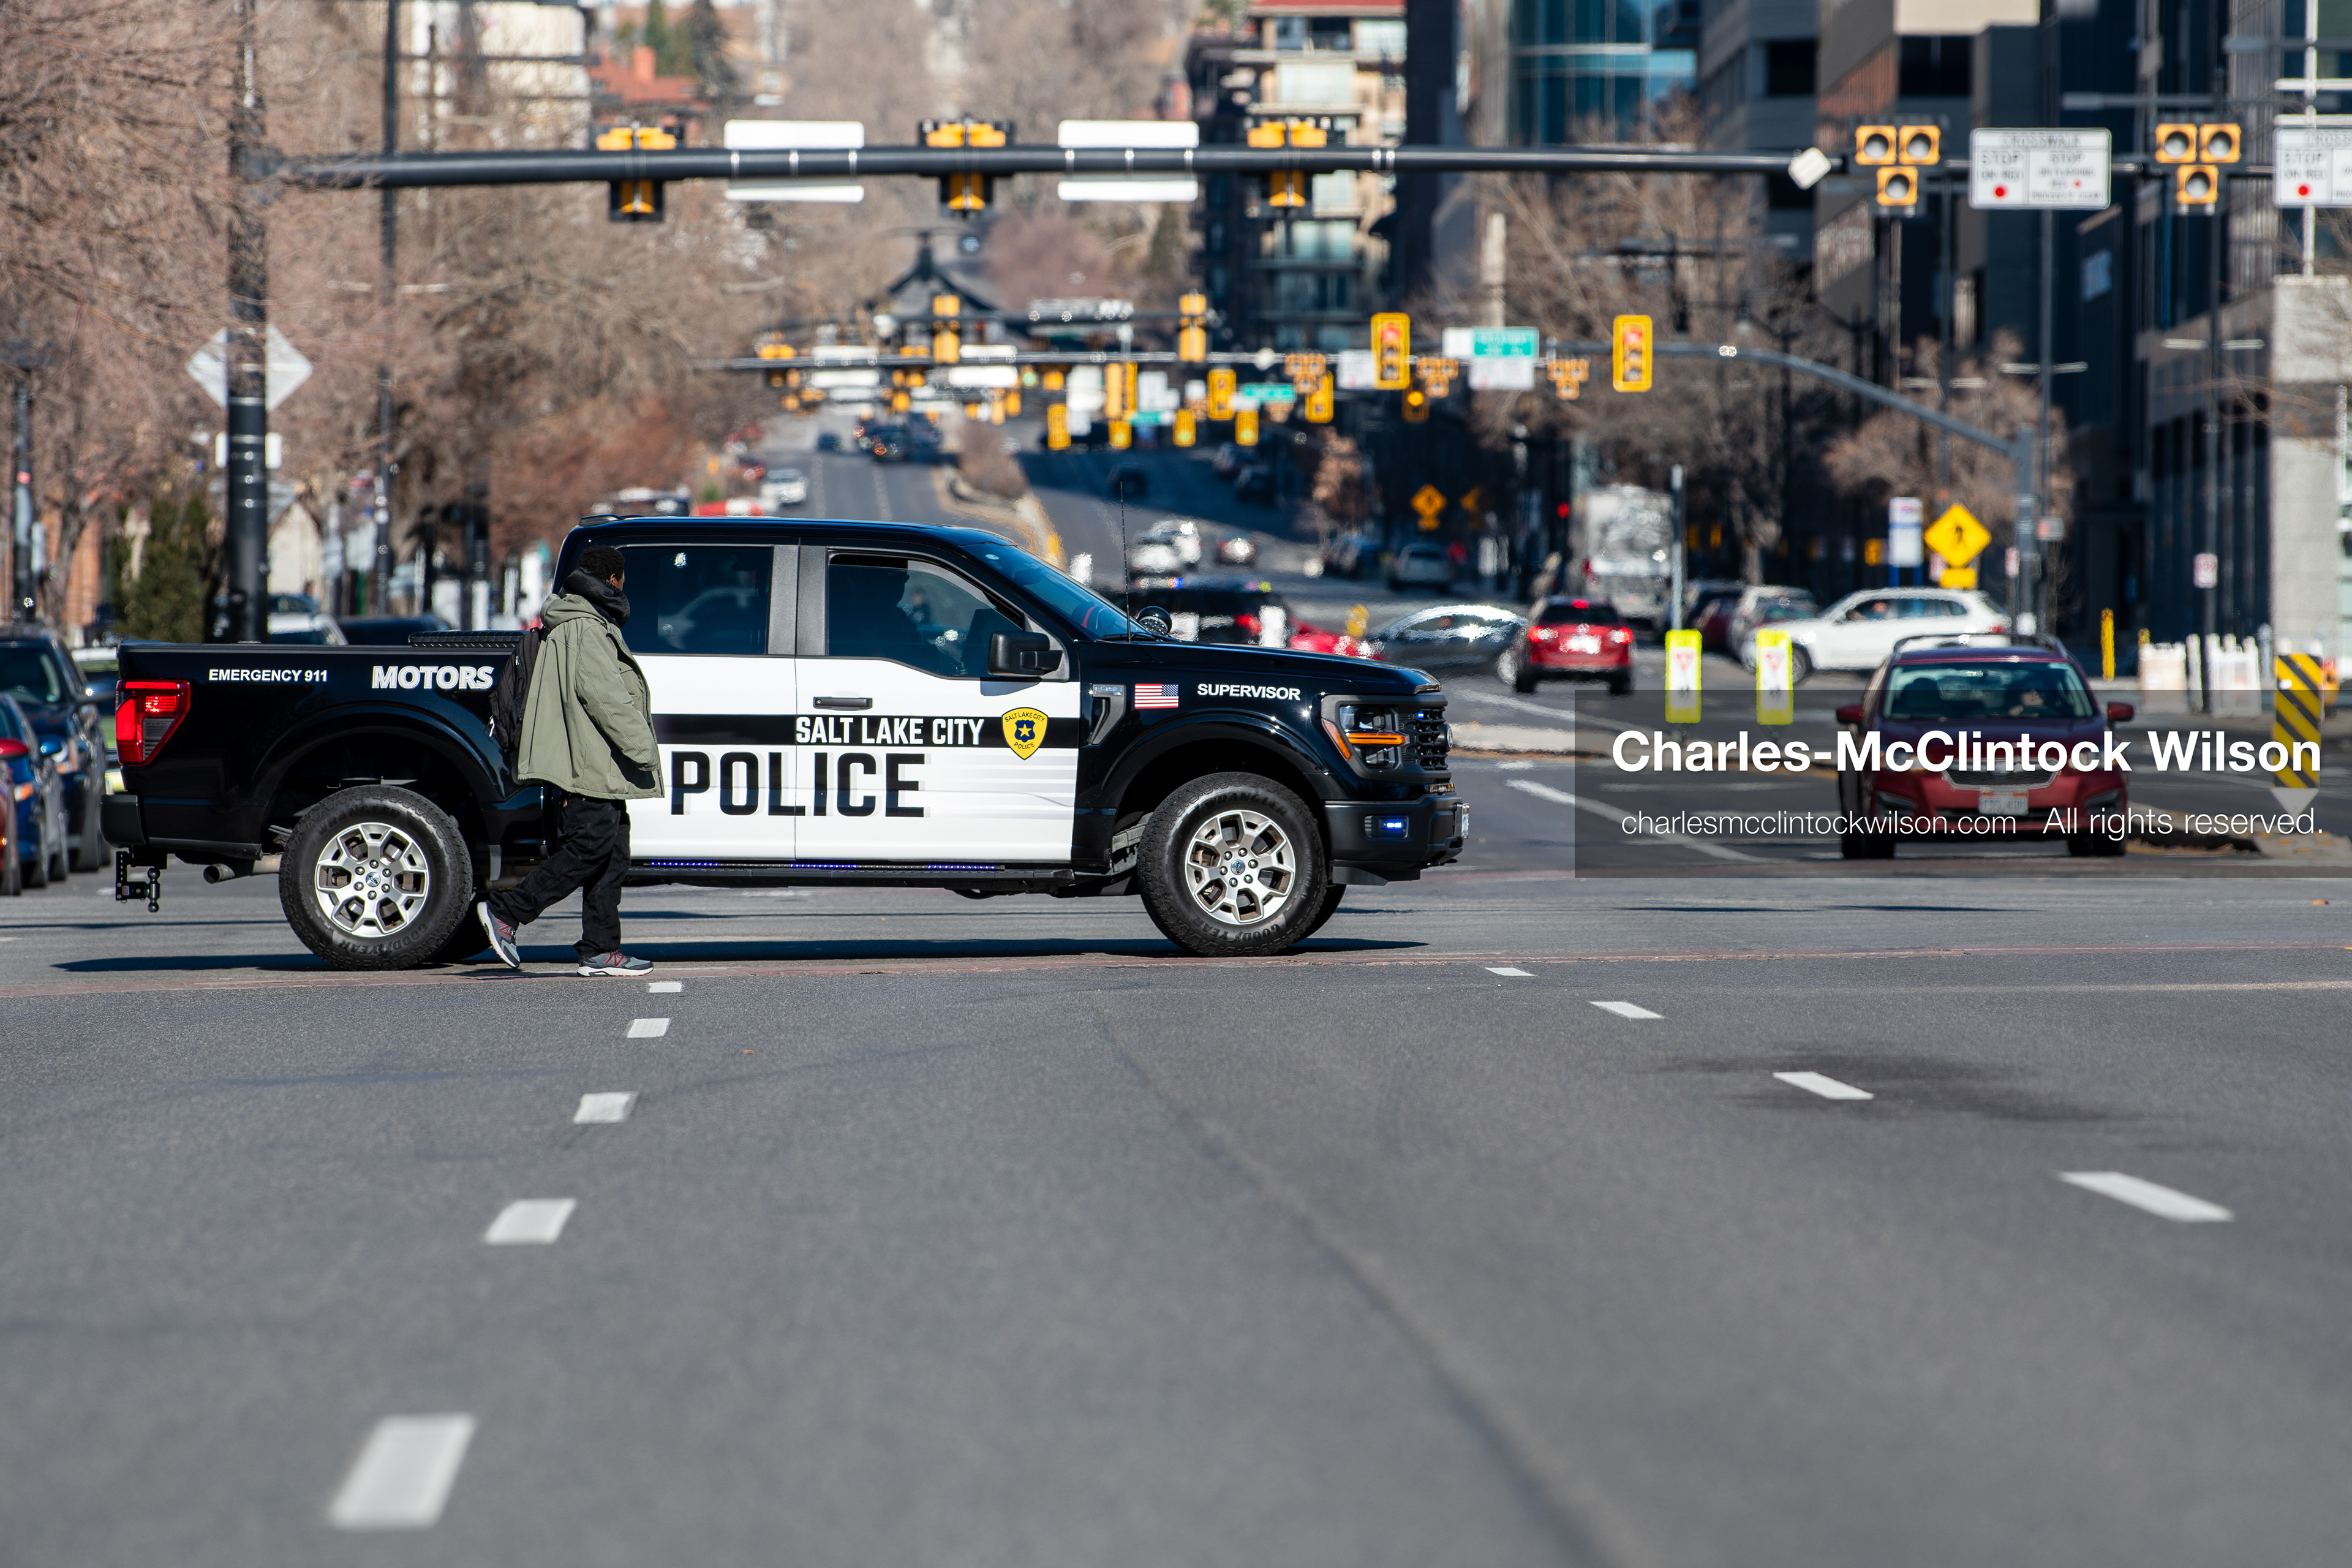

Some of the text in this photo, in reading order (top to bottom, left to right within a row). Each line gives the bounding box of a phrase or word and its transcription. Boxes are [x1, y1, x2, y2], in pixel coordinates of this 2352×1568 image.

[2002, 132, 2082, 147] CROSSWALK
[1981, 151, 2023, 165] STOP
[2050, 151, 2084, 164] STOP
[2284, 149, 2327, 164] STOP
[1981, 168, 2024, 180] ON RED
[2285, 168, 2328, 180] ON RED
[208, 669, 328, 682] EMERGENCY 911
[371, 666, 494, 690] MOTORS
[1197, 683, 1301, 701] SUPERVISOR
[1005, 713, 1017, 722] SALT
[1033, 713, 1045, 722] CITY
[797, 716, 984, 745] SALT LAKE CITY
[671, 751, 926, 818] POLICE
[1204, 793, 1289, 818] WRANGLER
